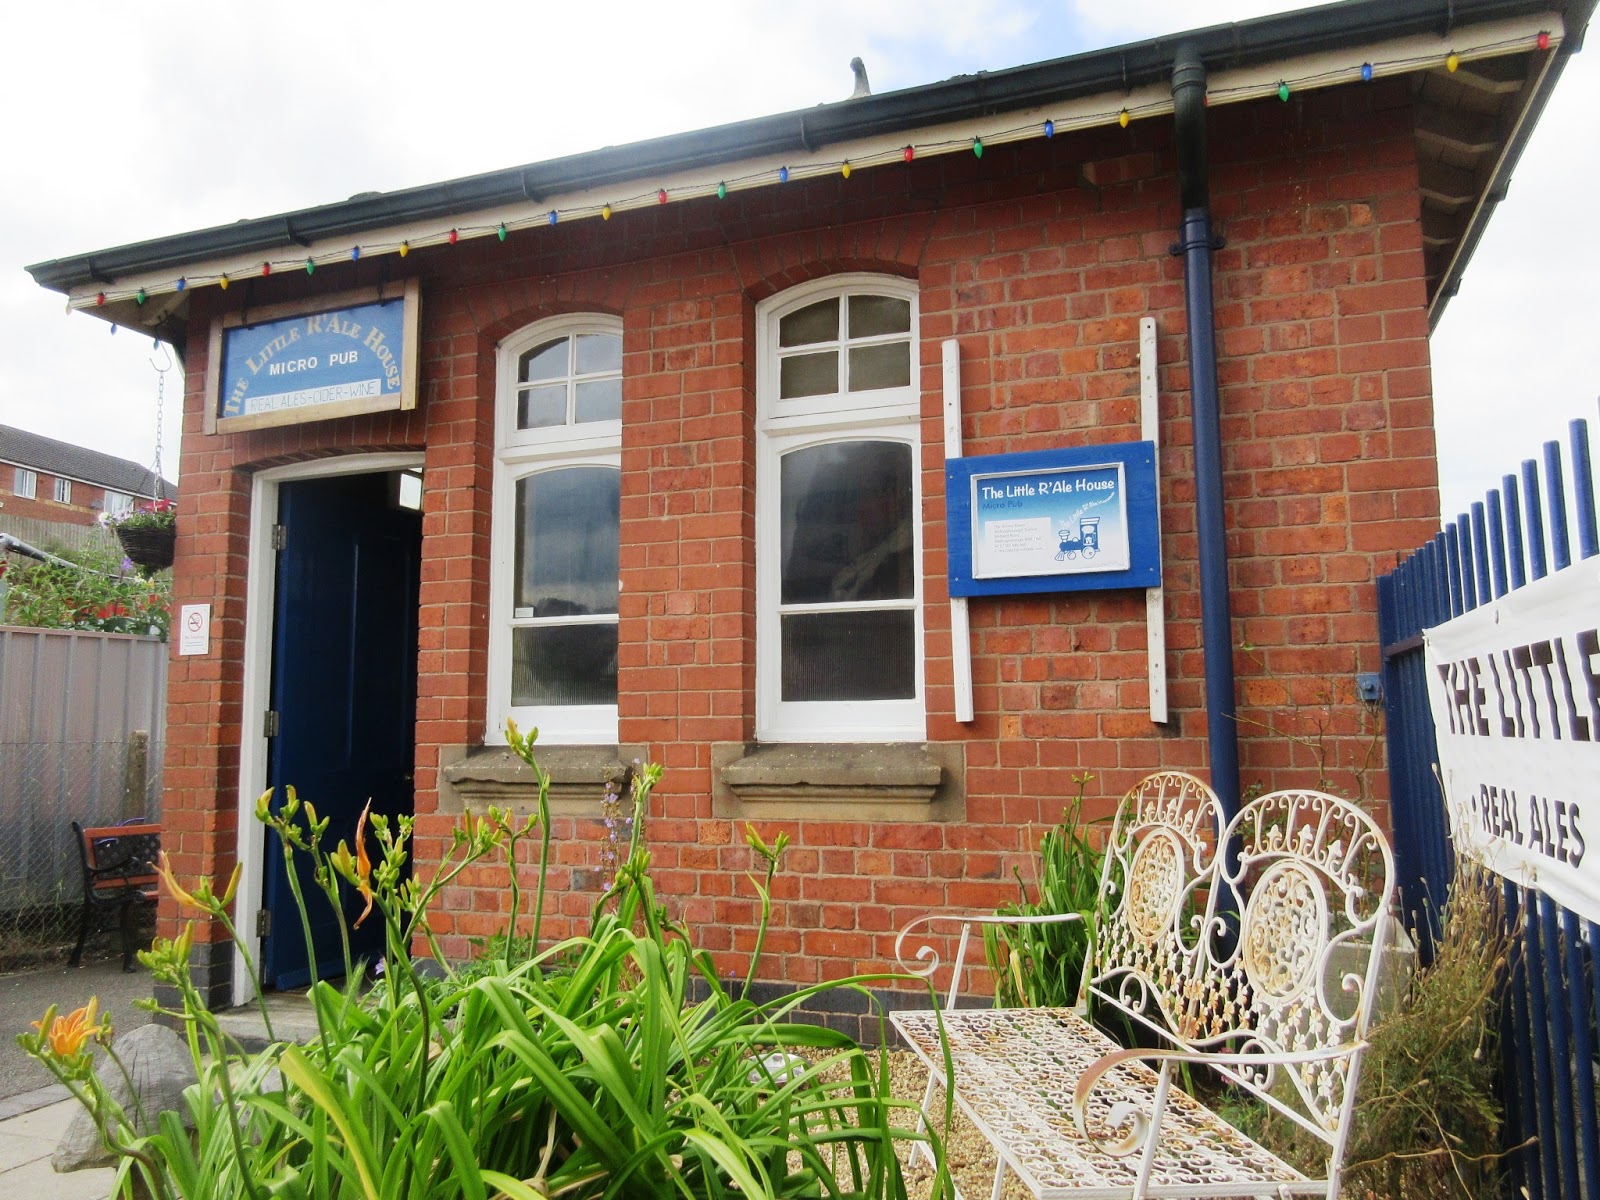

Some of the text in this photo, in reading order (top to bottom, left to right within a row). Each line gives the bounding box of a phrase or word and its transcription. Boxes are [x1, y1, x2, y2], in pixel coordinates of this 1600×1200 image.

[223, 313, 401, 418] THE LITTLE R'ALE HOUSE
[269, 350, 358, 376] MICRO PUB
[250, 396, 276, 412] REAL
[981, 478, 1115, 500] The Little R'Ale House
[982, 499, 1023, 510] Micro Pub
[1436, 628, 1600, 742] THE LITTLE
[1480, 783, 1586, 869] REAL ALES
